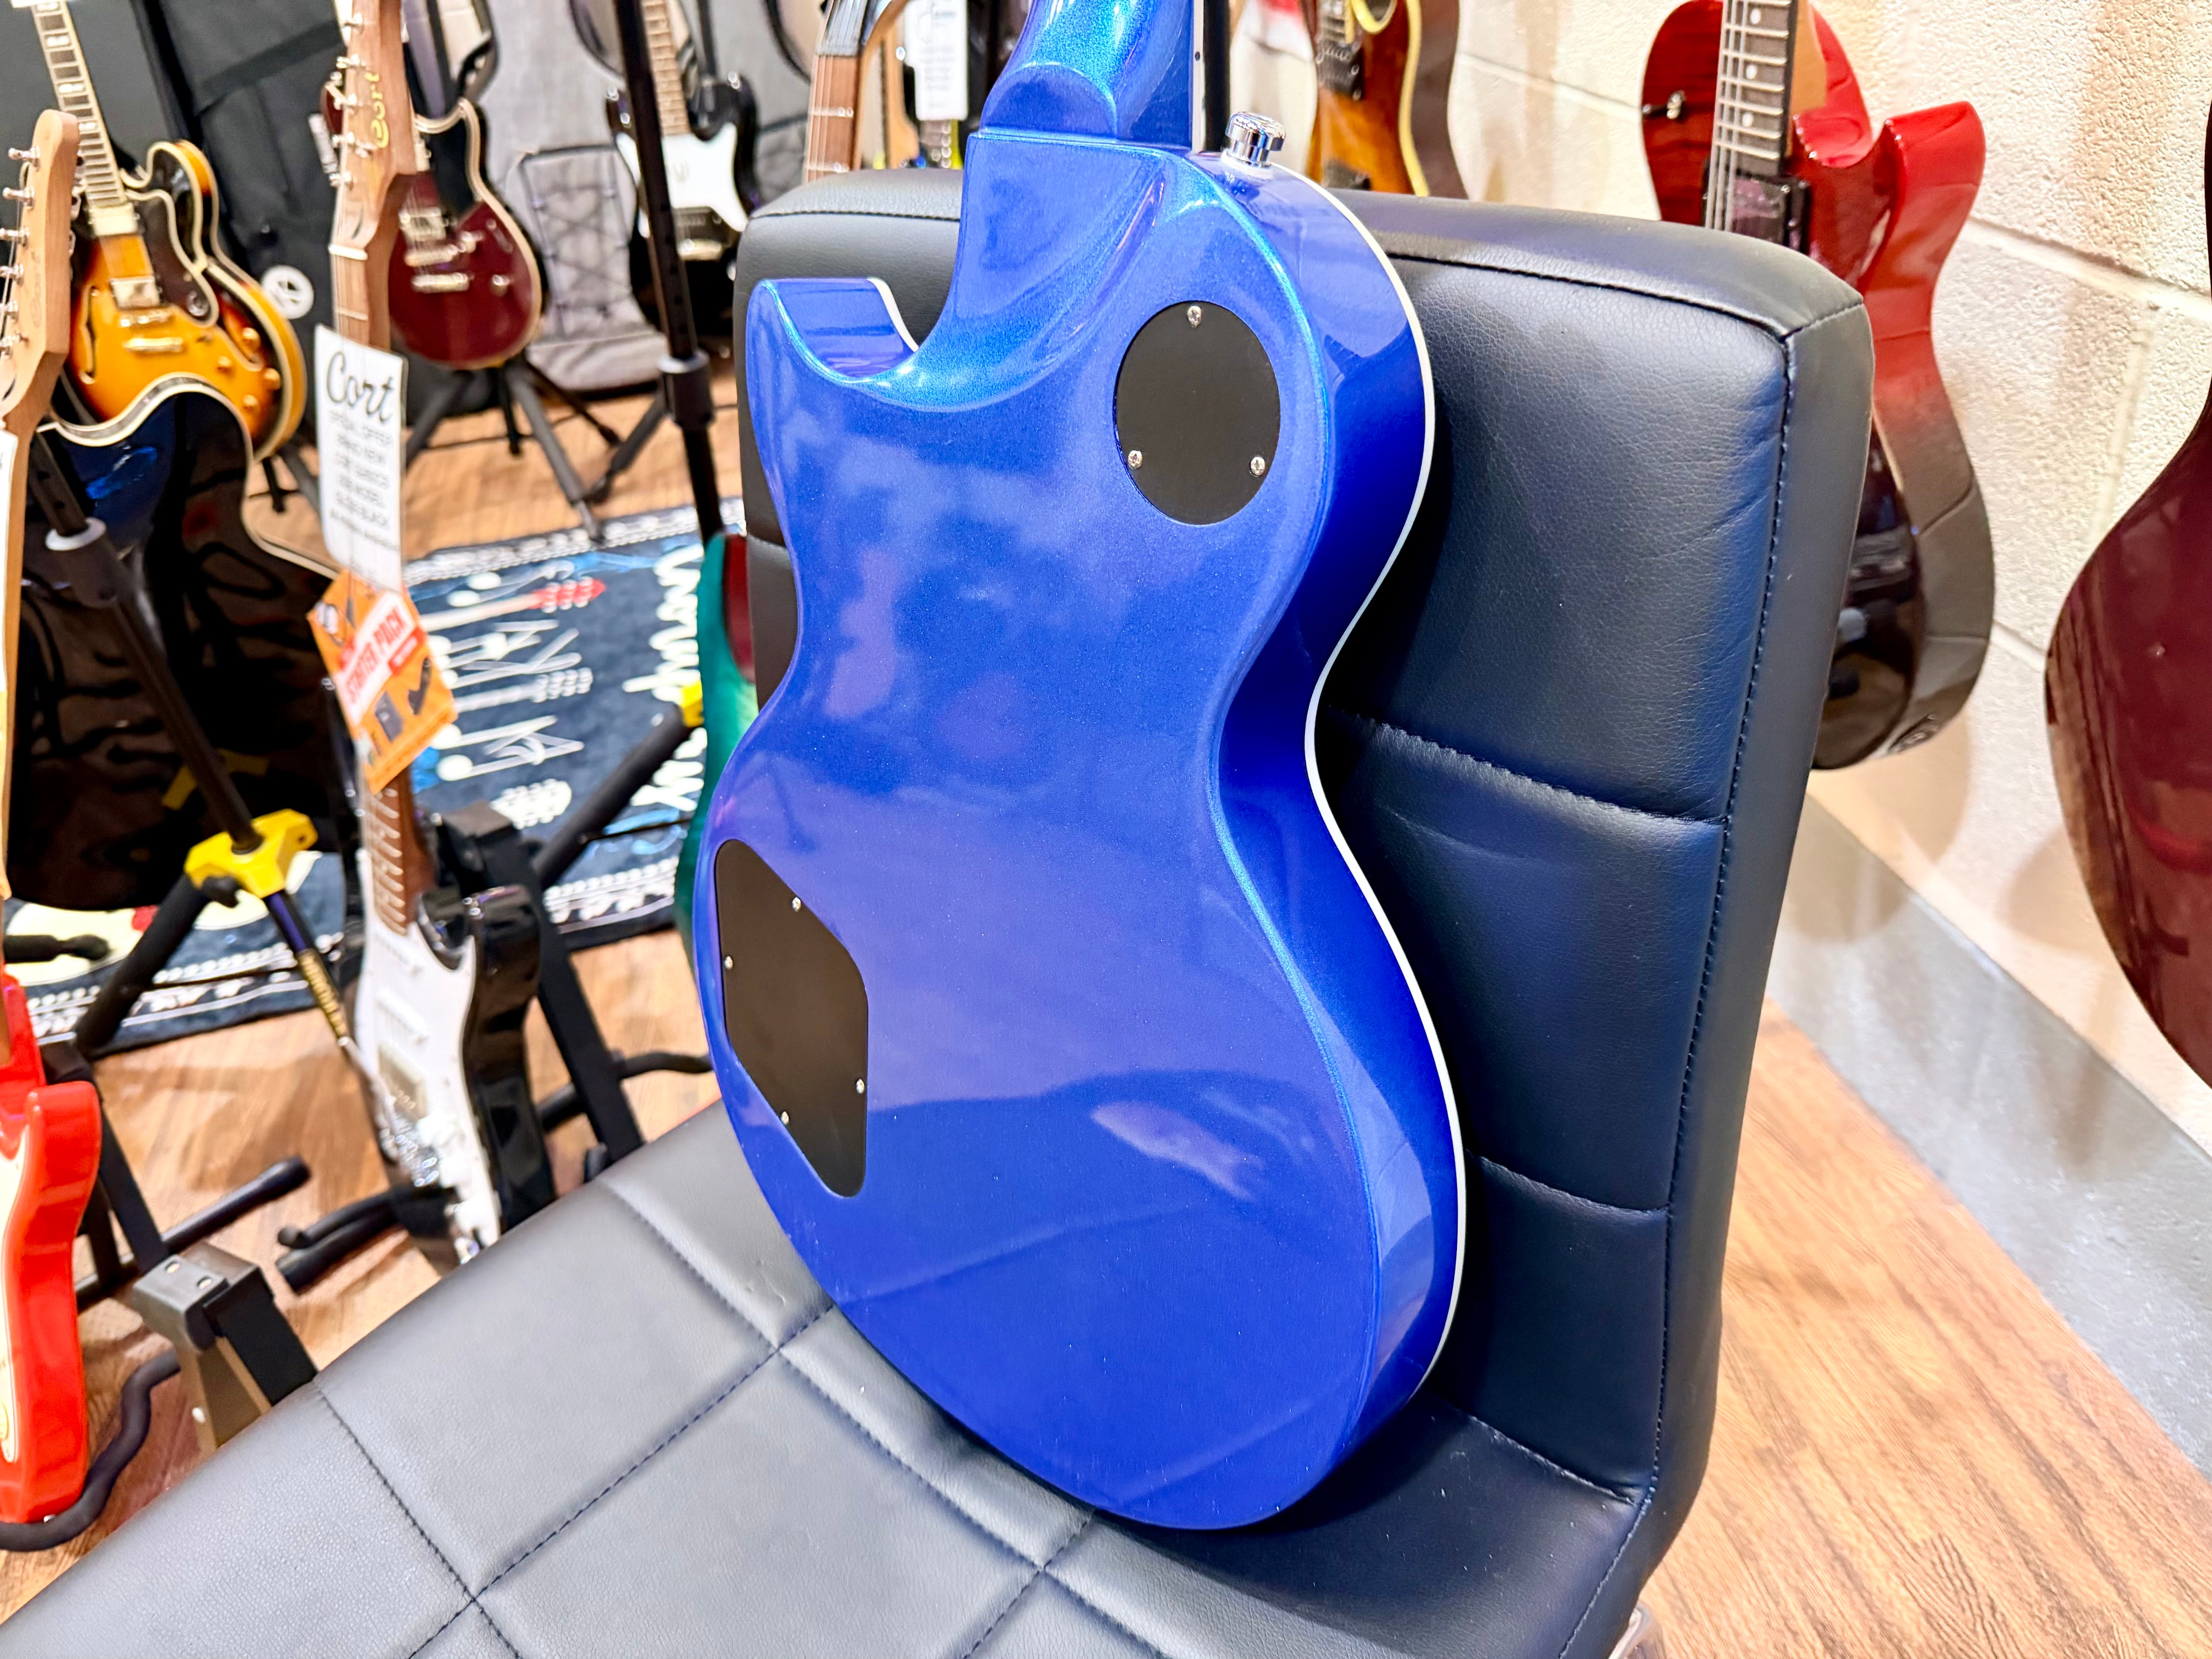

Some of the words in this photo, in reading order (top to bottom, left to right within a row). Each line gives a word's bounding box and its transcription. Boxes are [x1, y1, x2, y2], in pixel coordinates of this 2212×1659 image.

[364, 71, 389, 148] Cort
[327, 351, 395, 423] Cort
[373, 606, 405, 656] PACK
